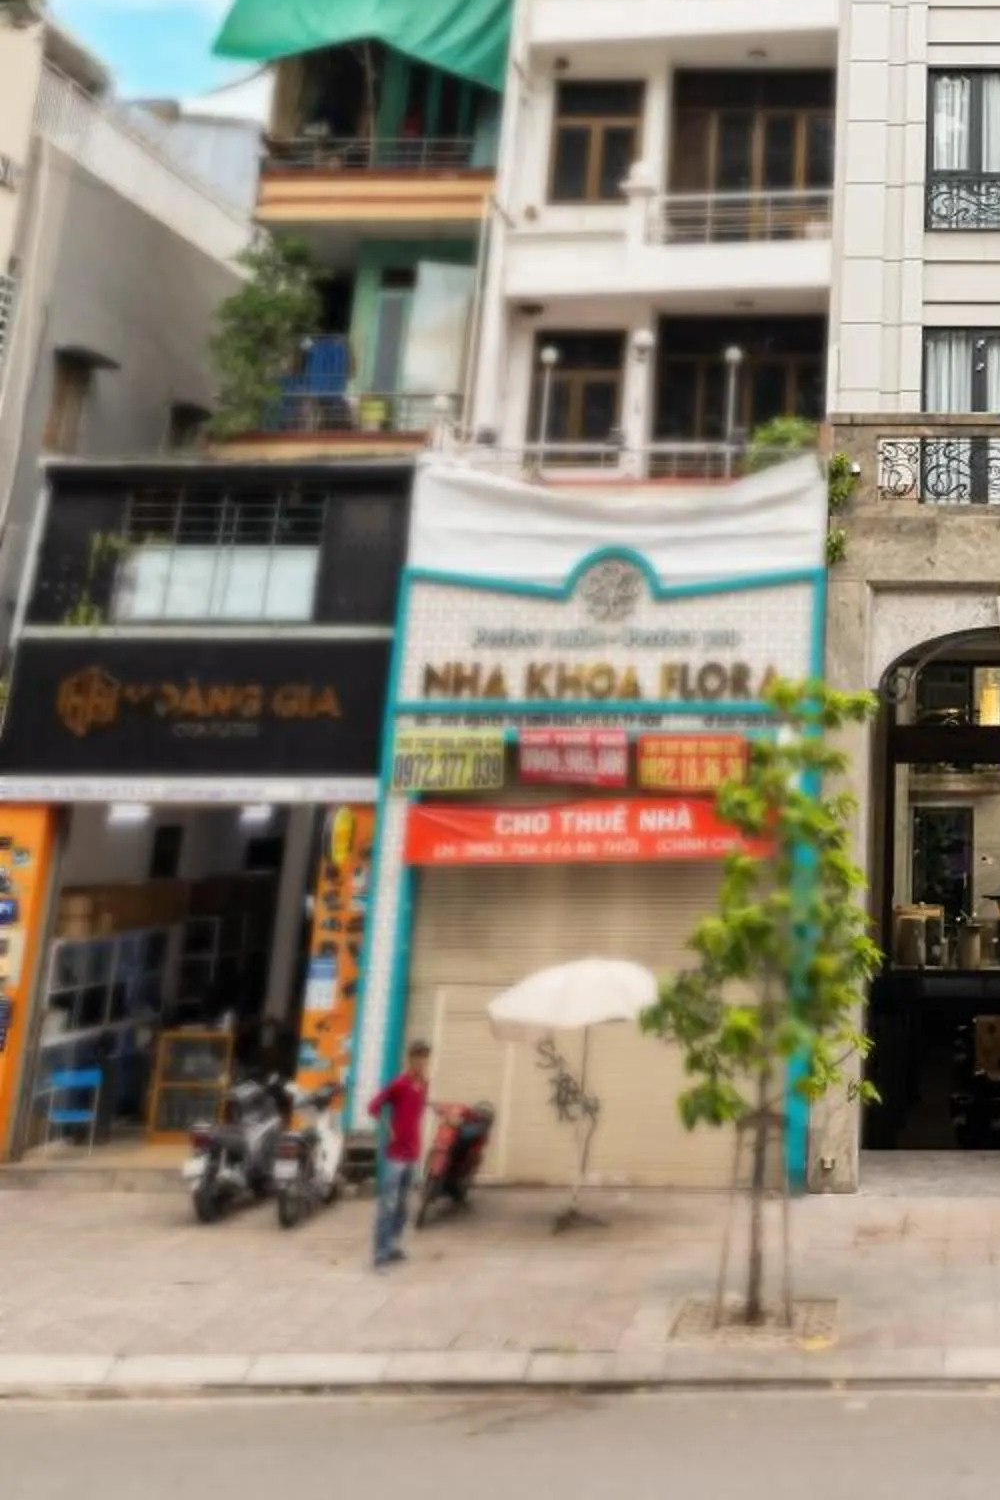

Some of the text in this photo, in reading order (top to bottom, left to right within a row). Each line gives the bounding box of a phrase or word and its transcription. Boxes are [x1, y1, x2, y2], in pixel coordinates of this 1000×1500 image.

[423, 661, 507, 699] NHA
[524, 661, 641, 699] KHOA
[494, 810, 550, 835] CHO
[638, 799, 692, 832] NHÀ
